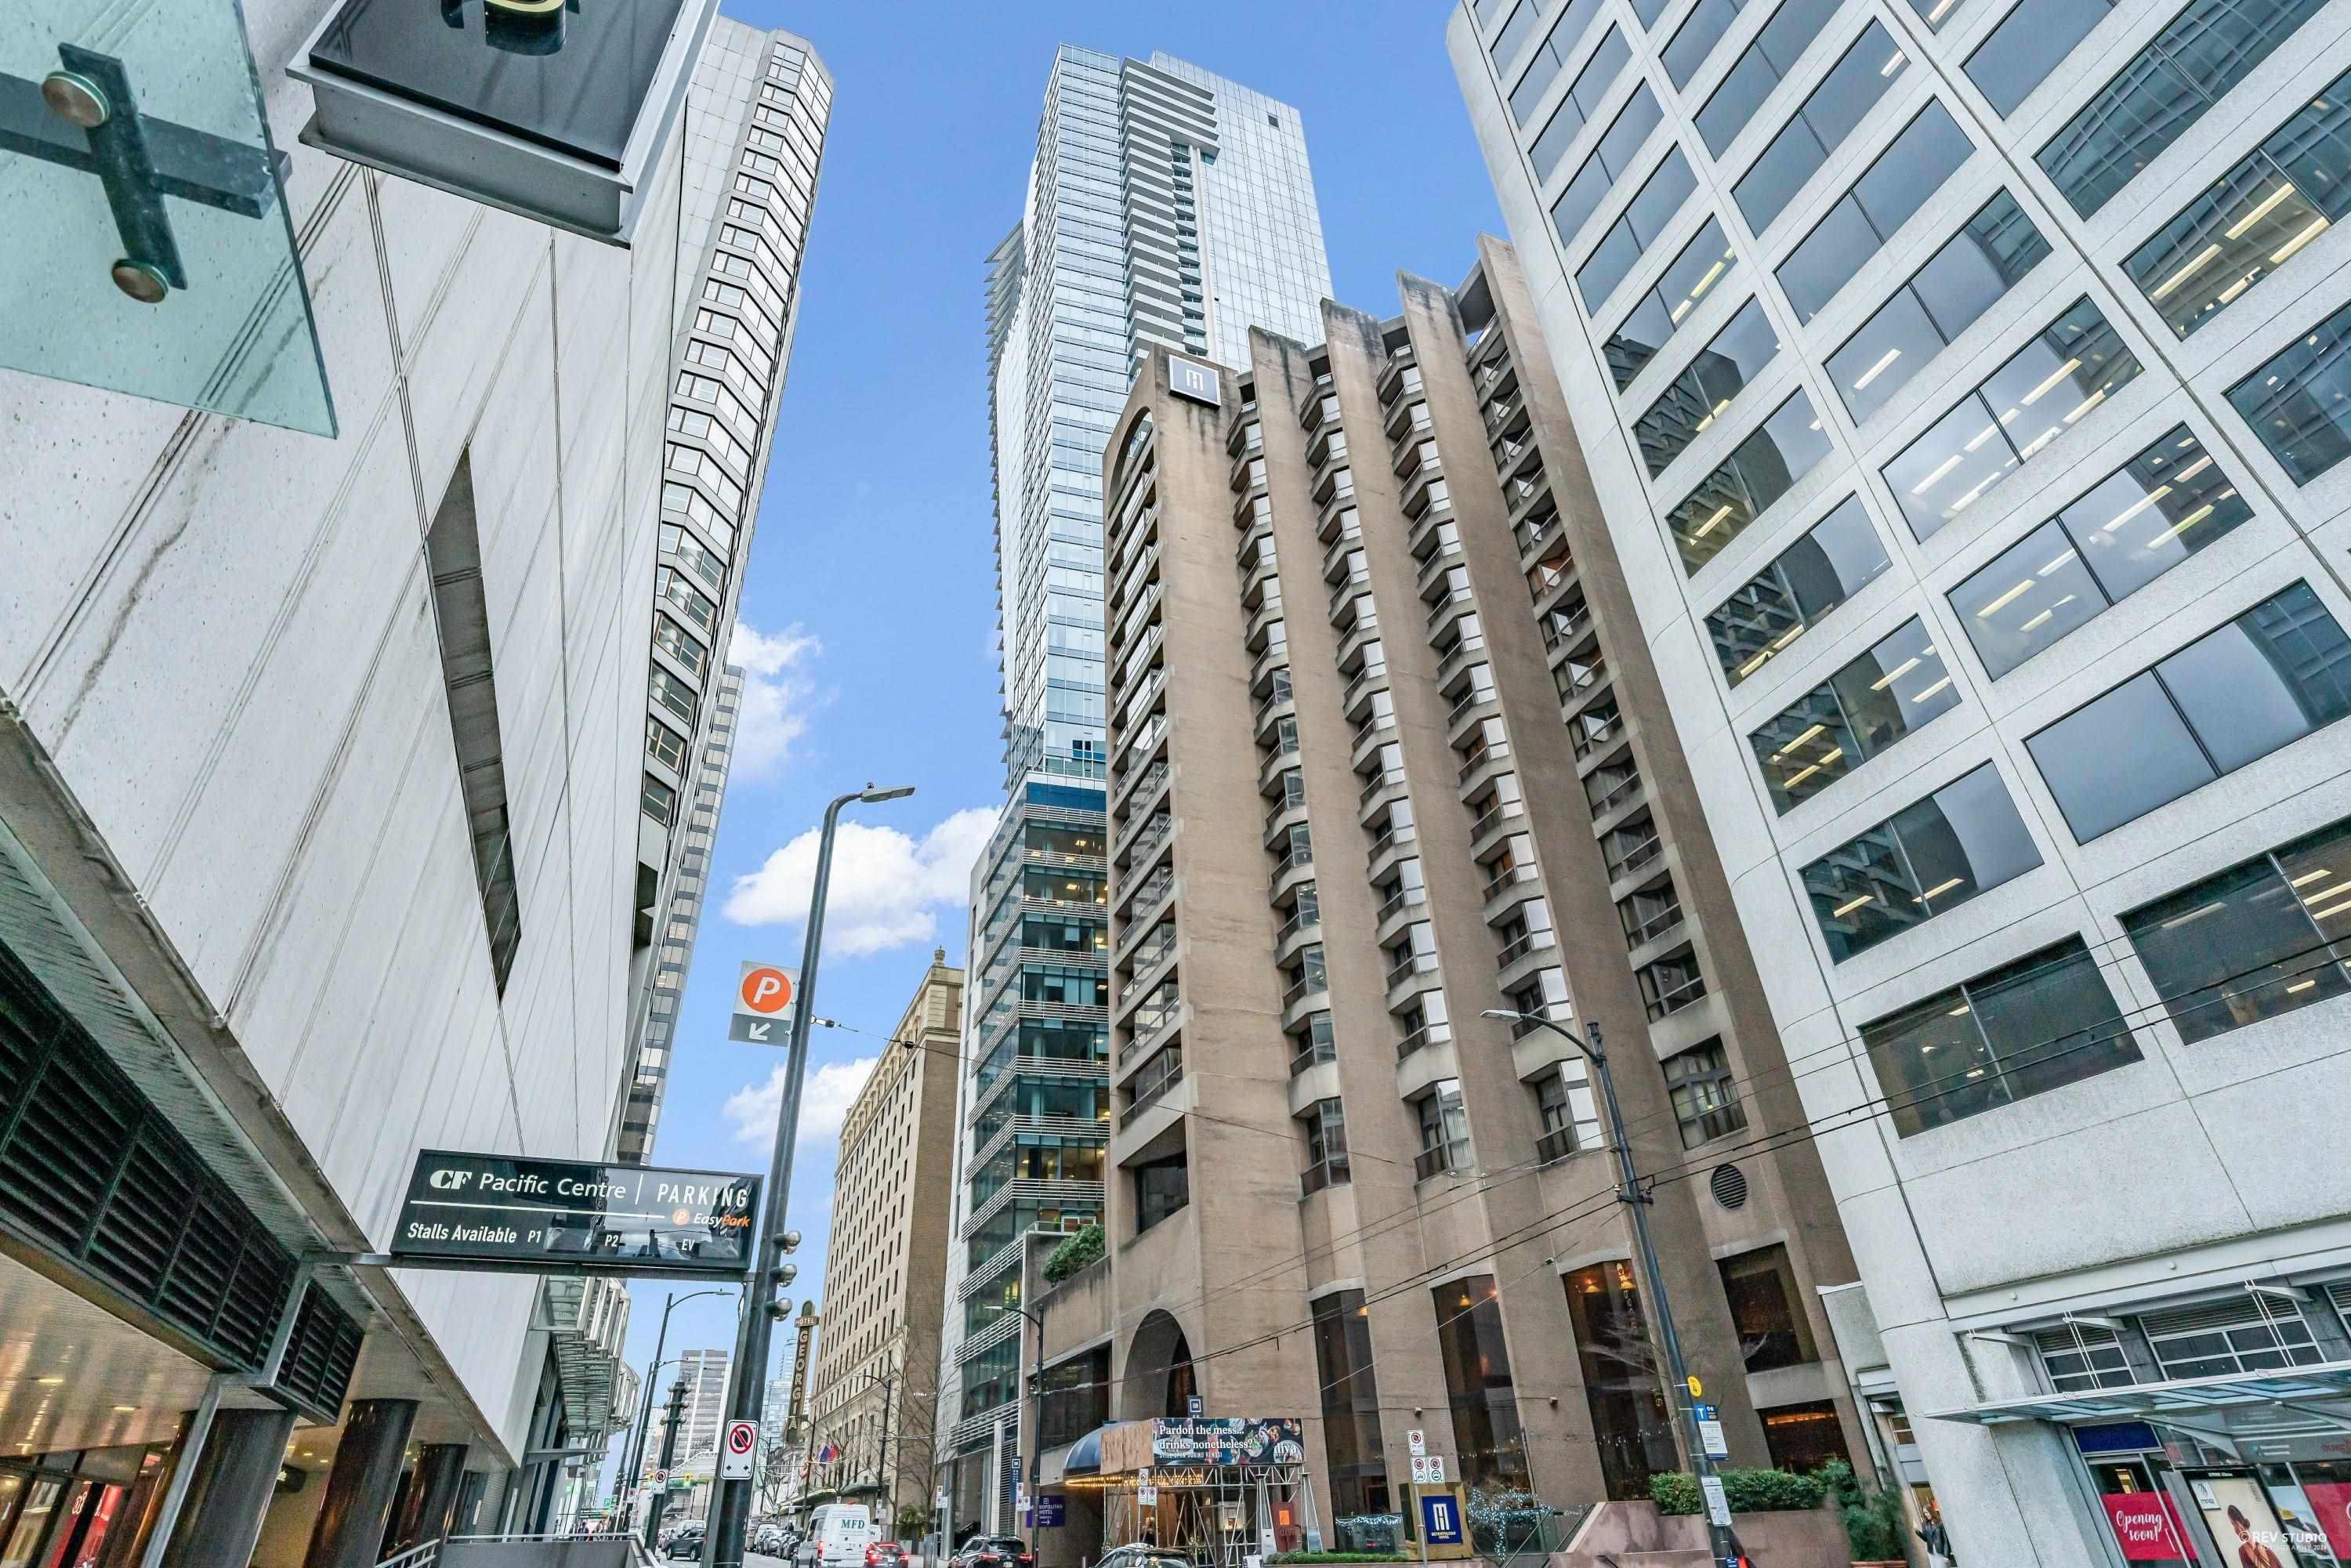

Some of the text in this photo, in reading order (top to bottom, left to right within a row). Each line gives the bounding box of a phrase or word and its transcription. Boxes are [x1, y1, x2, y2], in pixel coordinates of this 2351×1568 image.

[753, 976, 781, 1004] P
[429, 1170, 748, 1208] CF Pacific Centre PARKING
[693, 1213, 751, 1228] EasyPark
[408, 1222, 695, 1251] Stalls Available P1 P2 EV
[788, 1330, 809, 1430] GEORGIA
[1159, 1425, 1244, 1435] Pardon the mess...
[1159, 1439, 1254, 1450] drinks nonetheless?
[841, 1519, 865, 1529] MFD
[2116, 1510, 2162, 1534] Opening
[2128, 1525, 2159, 1542] soon!
